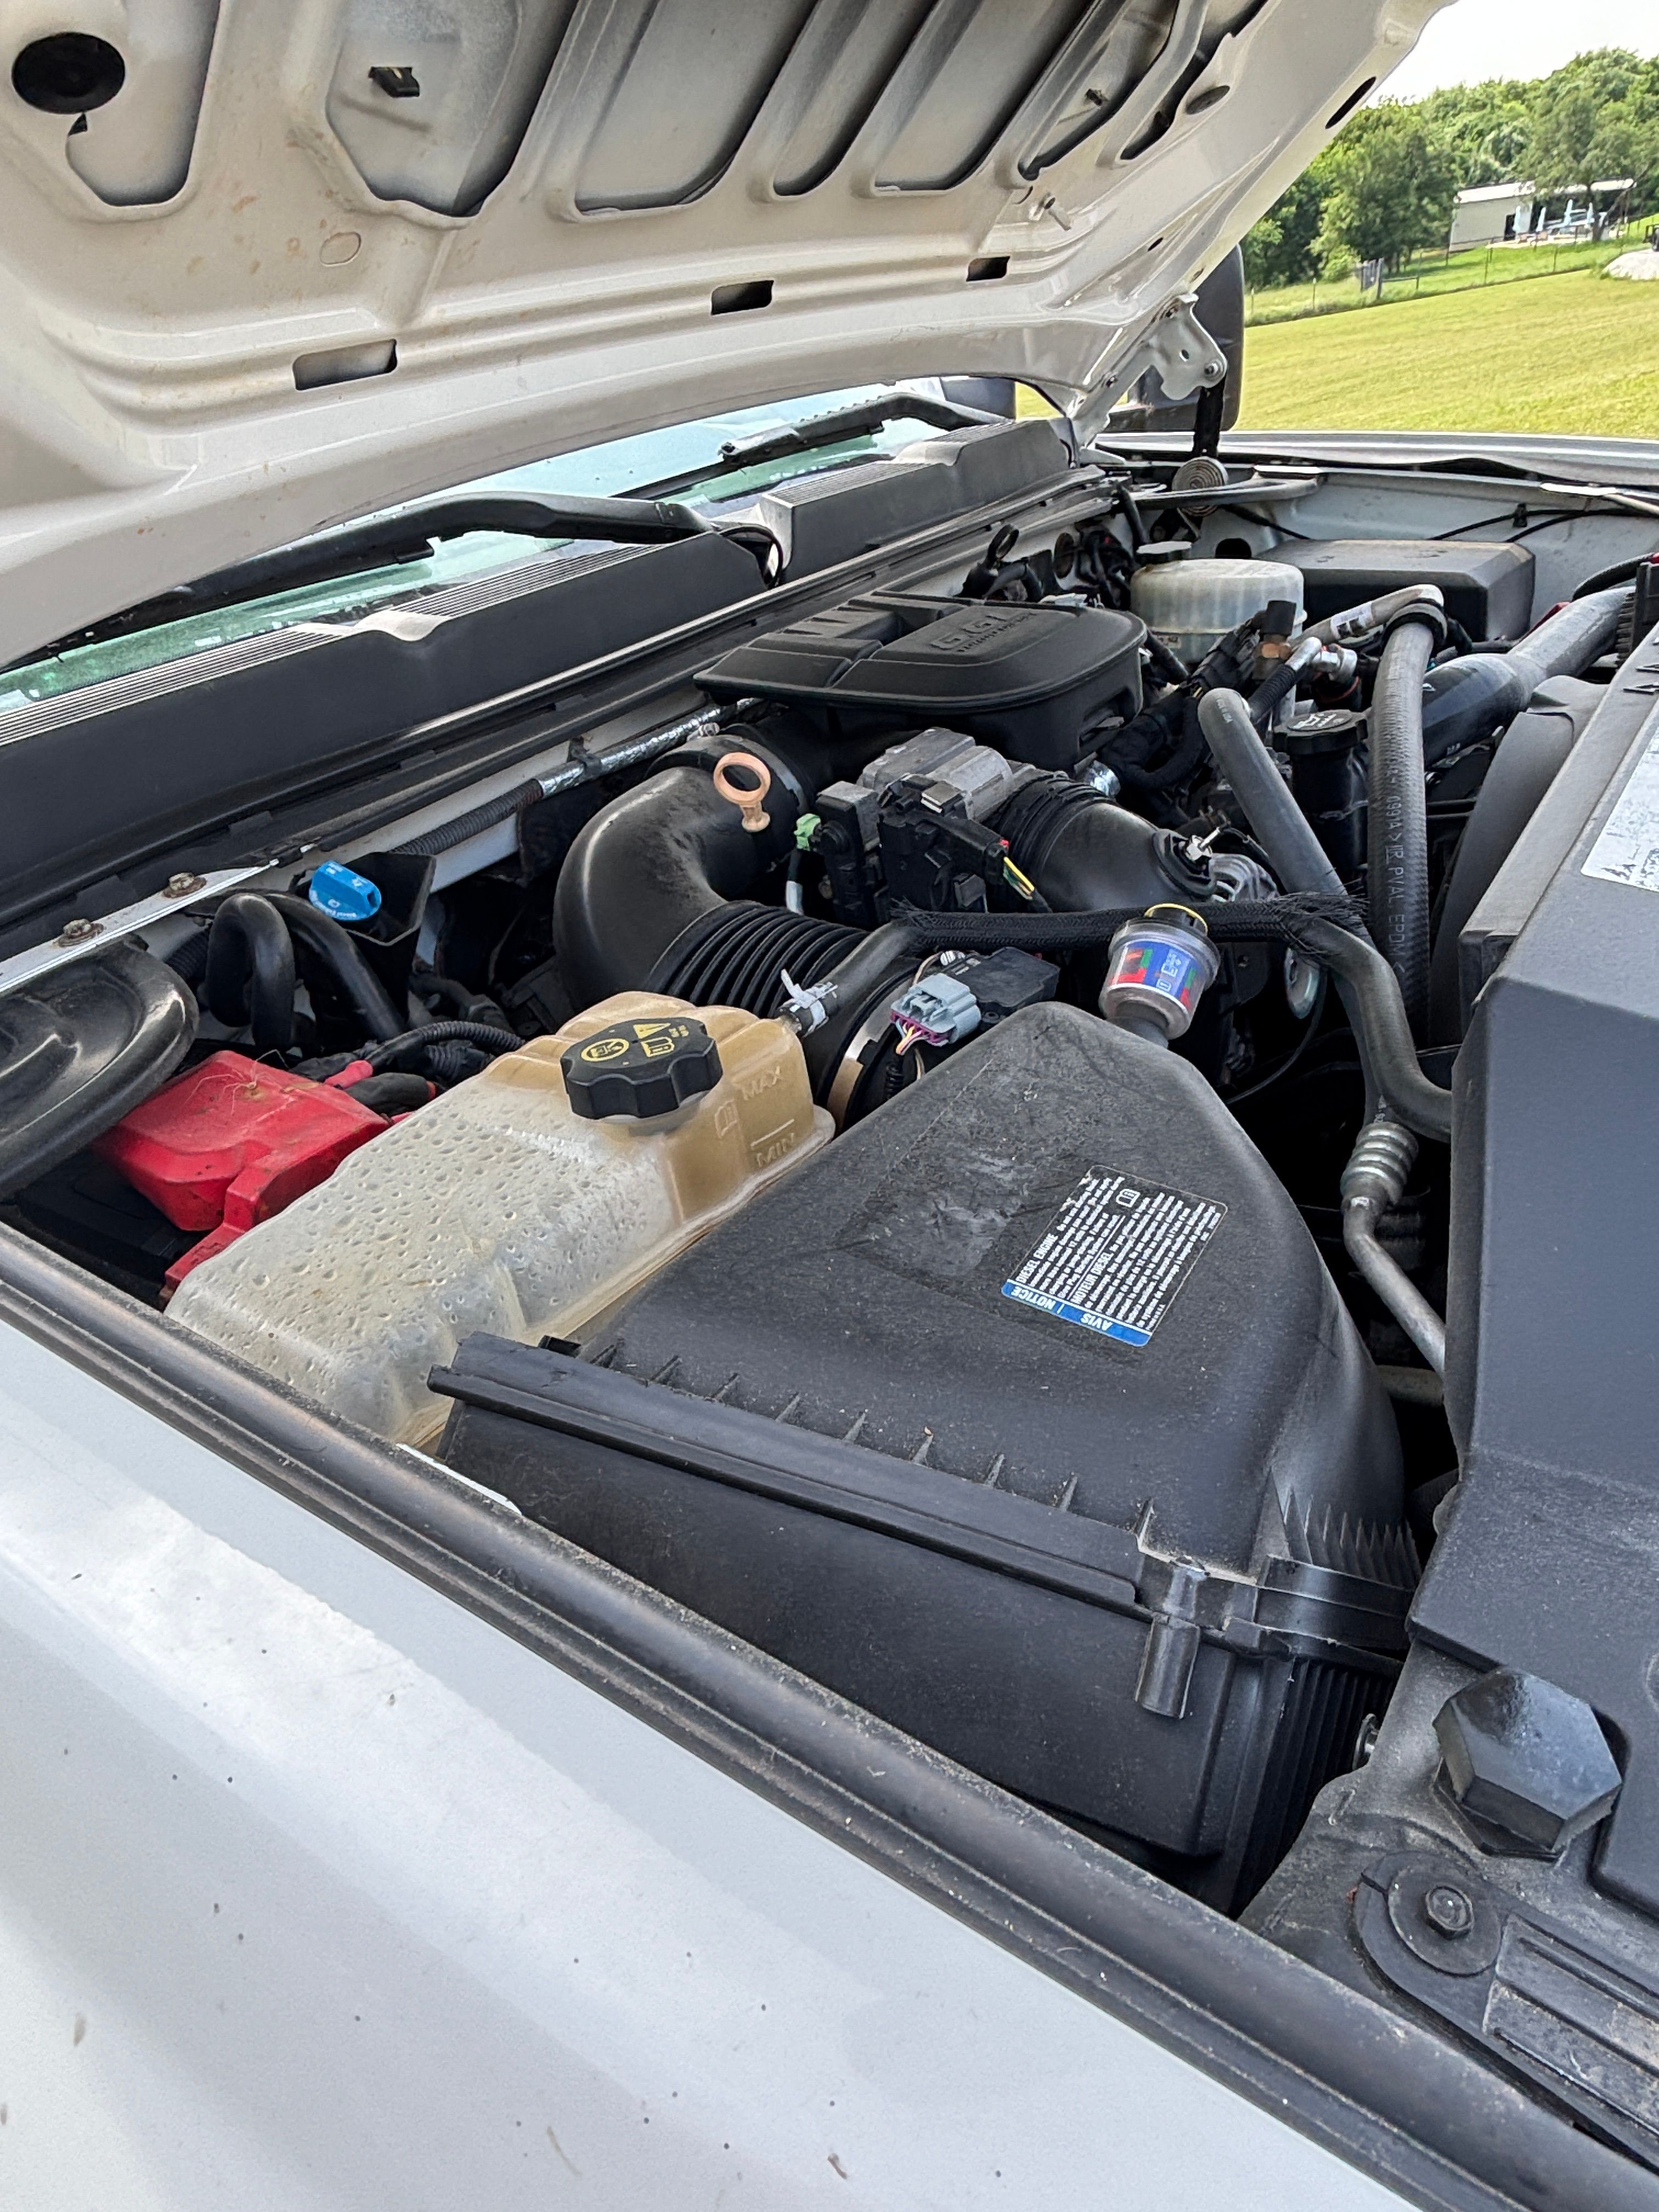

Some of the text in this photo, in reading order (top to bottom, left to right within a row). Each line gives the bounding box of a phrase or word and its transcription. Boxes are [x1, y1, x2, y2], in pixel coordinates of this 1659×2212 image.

[1387, 867, 1405, 904] PVAL
[1388, 914, 1406, 956] EPDM
[742, 1065, 782, 1101] MAX
[757, 1132, 795, 1167] MIN
[1014, 1233, 1059, 1284] DIESEL ENGINE
[1069, 1250, 1114, 1305] MOTEUR DIESEL
[1012, 1286, 1113, 1331] AVIS NOTICE
